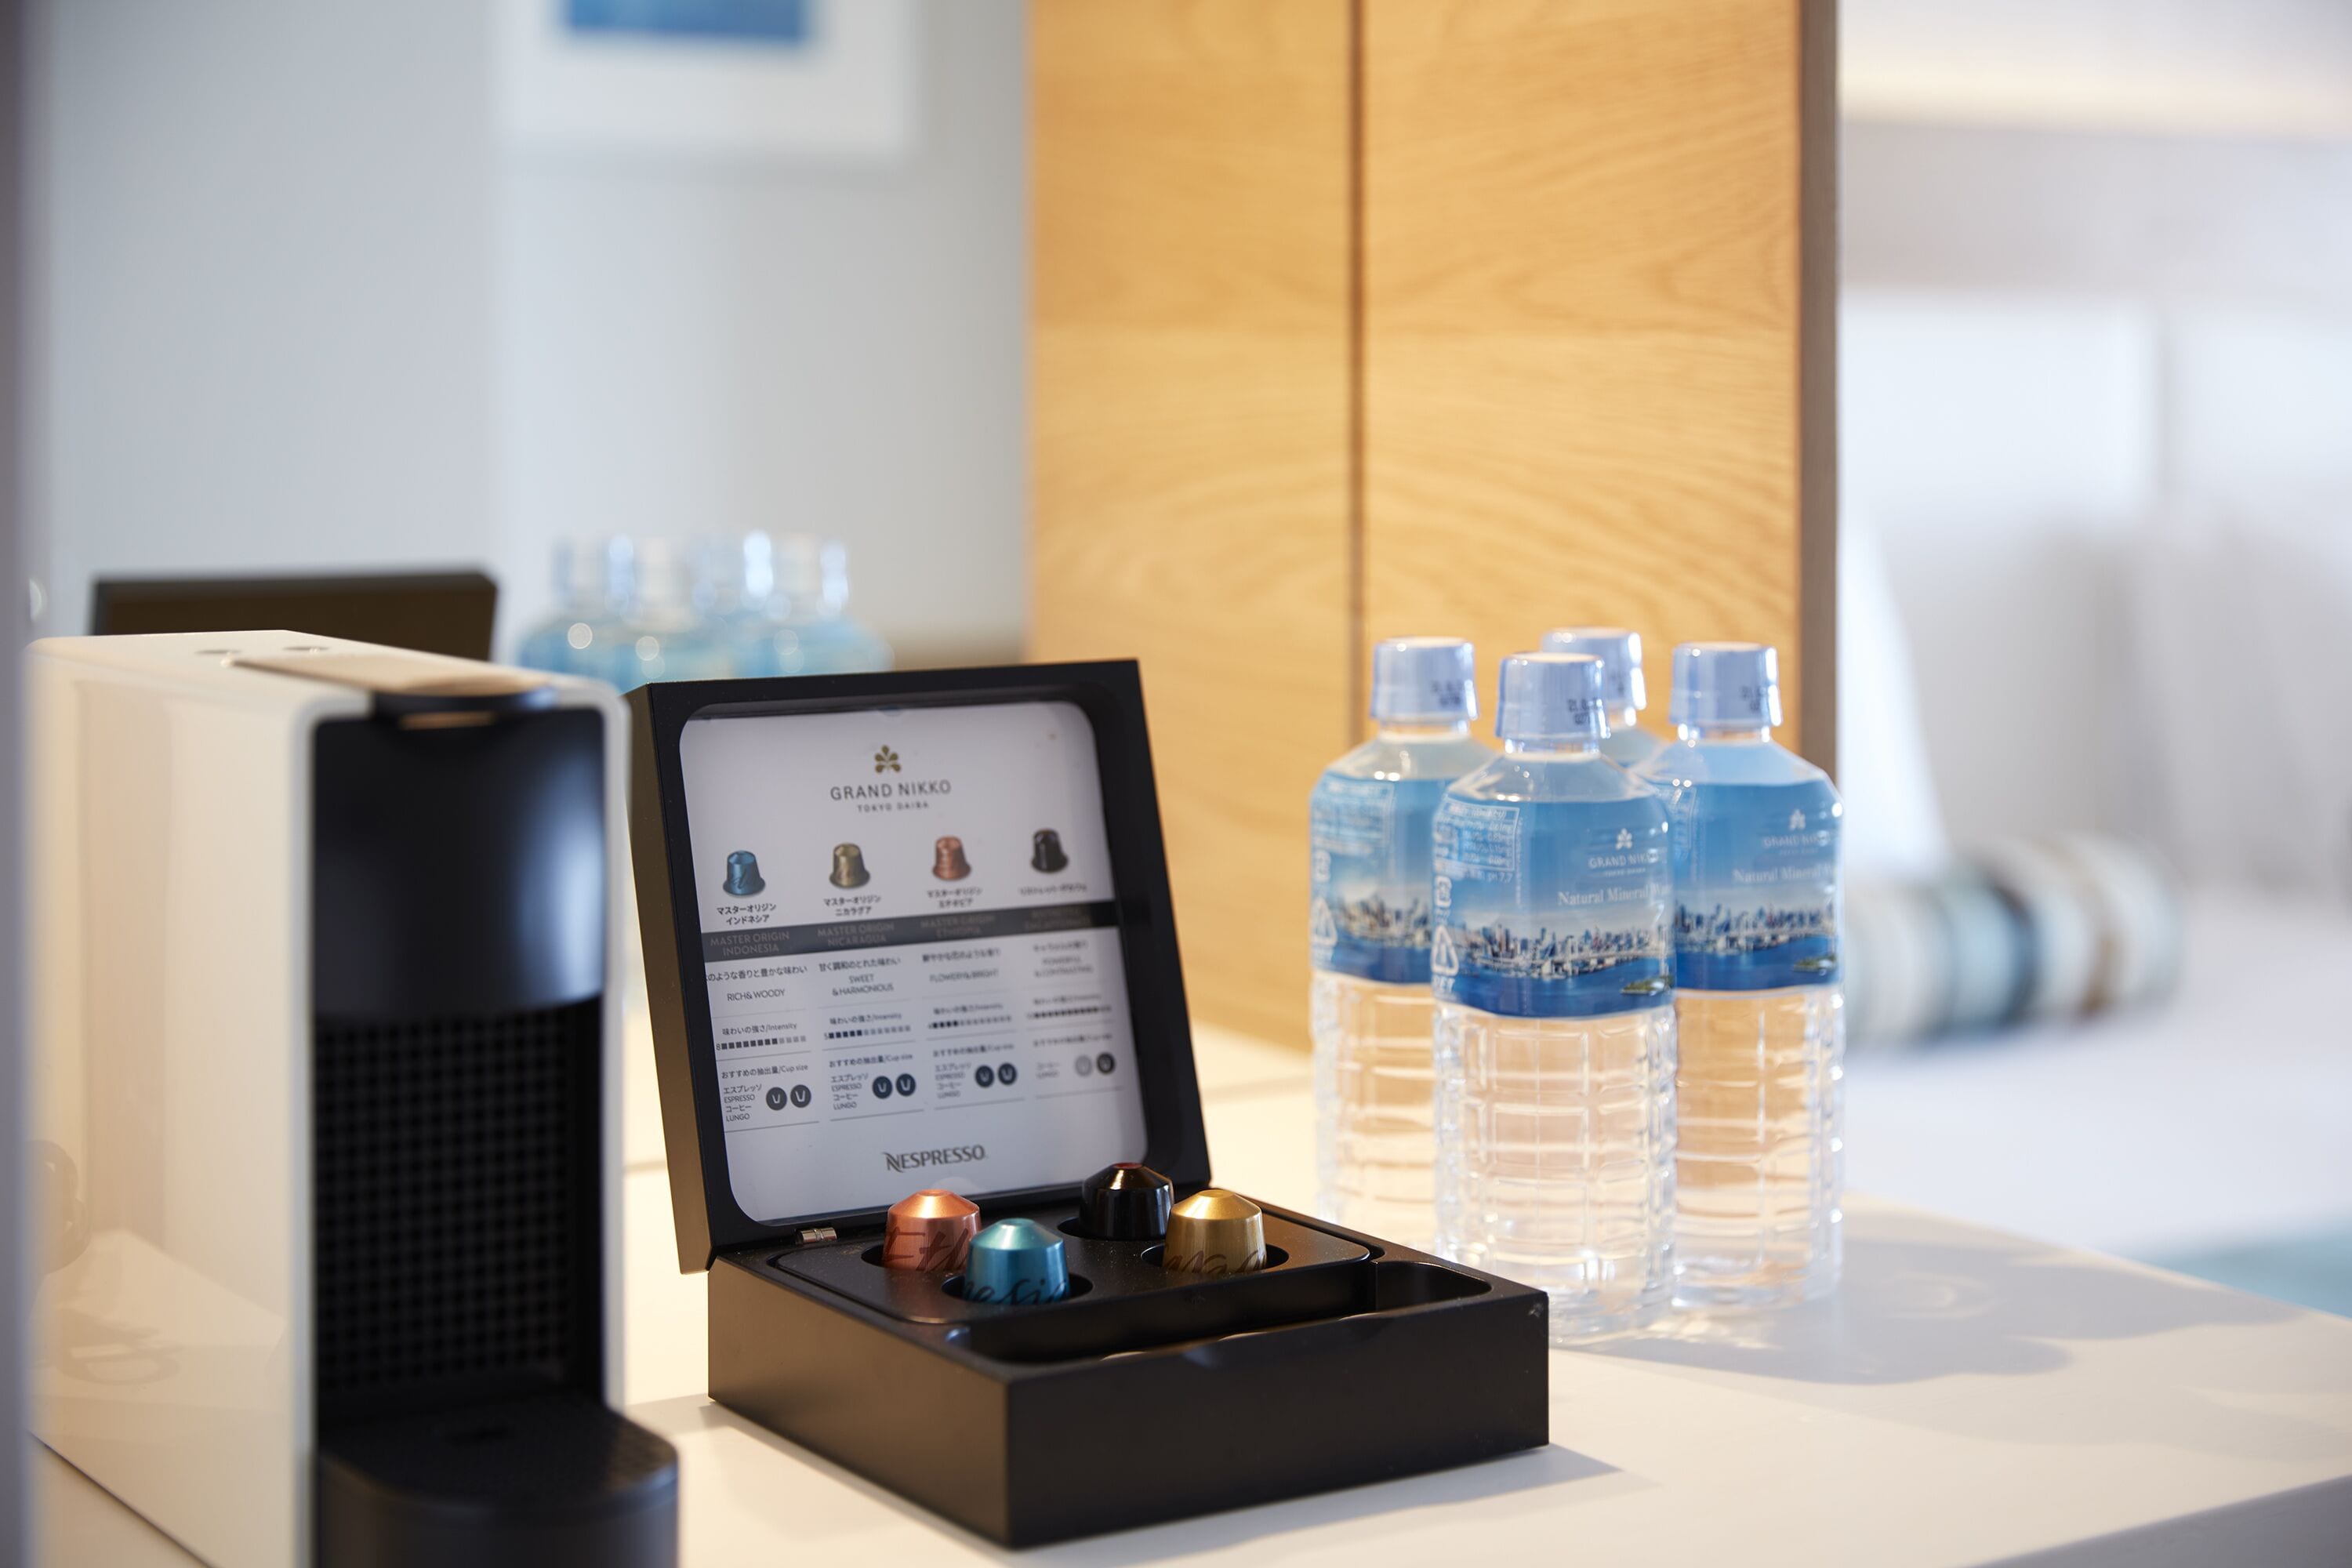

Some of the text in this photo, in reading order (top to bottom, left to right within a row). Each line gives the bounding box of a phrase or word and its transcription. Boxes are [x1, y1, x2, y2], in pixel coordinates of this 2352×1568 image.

[829, 779, 952, 800] GRAND NIKKO
[857, 801, 929, 813] TOKYO DAIBA
[1588, 855, 1627, 869] GRAND
[1732, 866, 1778, 883] Natural
[824, 895, 882, 906] マスターオリジン
[1558, 888, 1604, 906] Natural
[1606, 884, 1648, 902] Mineral
[717, 902, 777, 915] マスターオリジン
[835, 906, 872, 916] ニカラグア
[725, 914, 770, 926] インドネシア
[818, 922, 895, 937] MASTER ORIGIN
[710, 931, 790, 946] MASTER ORIGIN
[827, 935, 887, 947] NICARAGUA
[723, 944, 779, 956] INDONESIA
[818, 957, 902, 972] 甘く調和のとれた味わい
[706, 965, 808, 982] のような香りと豊かな味わい
[848, 973, 874, 984] SWEET
[753, 989, 786, 999] WOODY
[829, 1011, 902, 1025] 味わいの強さ/Intensity
[722, 1022, 797, 1036] 味わいの強さ/Intensity
[830, 1073, 869, 1083] エスプレッソ
[723, 1083, 763, 1094] エスプレッソ
[831, 1083, 862, 1092] ESPRESSO
[724, 1094, 756, 1104] ESPRESSO
[833, 1093, 858, 1102] コーヒー
[725, 1104, 752, 1113] コーヒー
[833, 1102, 858, 1111] LUNGO
[725, 1113, 750, 1122] LUNGO
[882, 1144, 986, 1173] NESPRESSO
